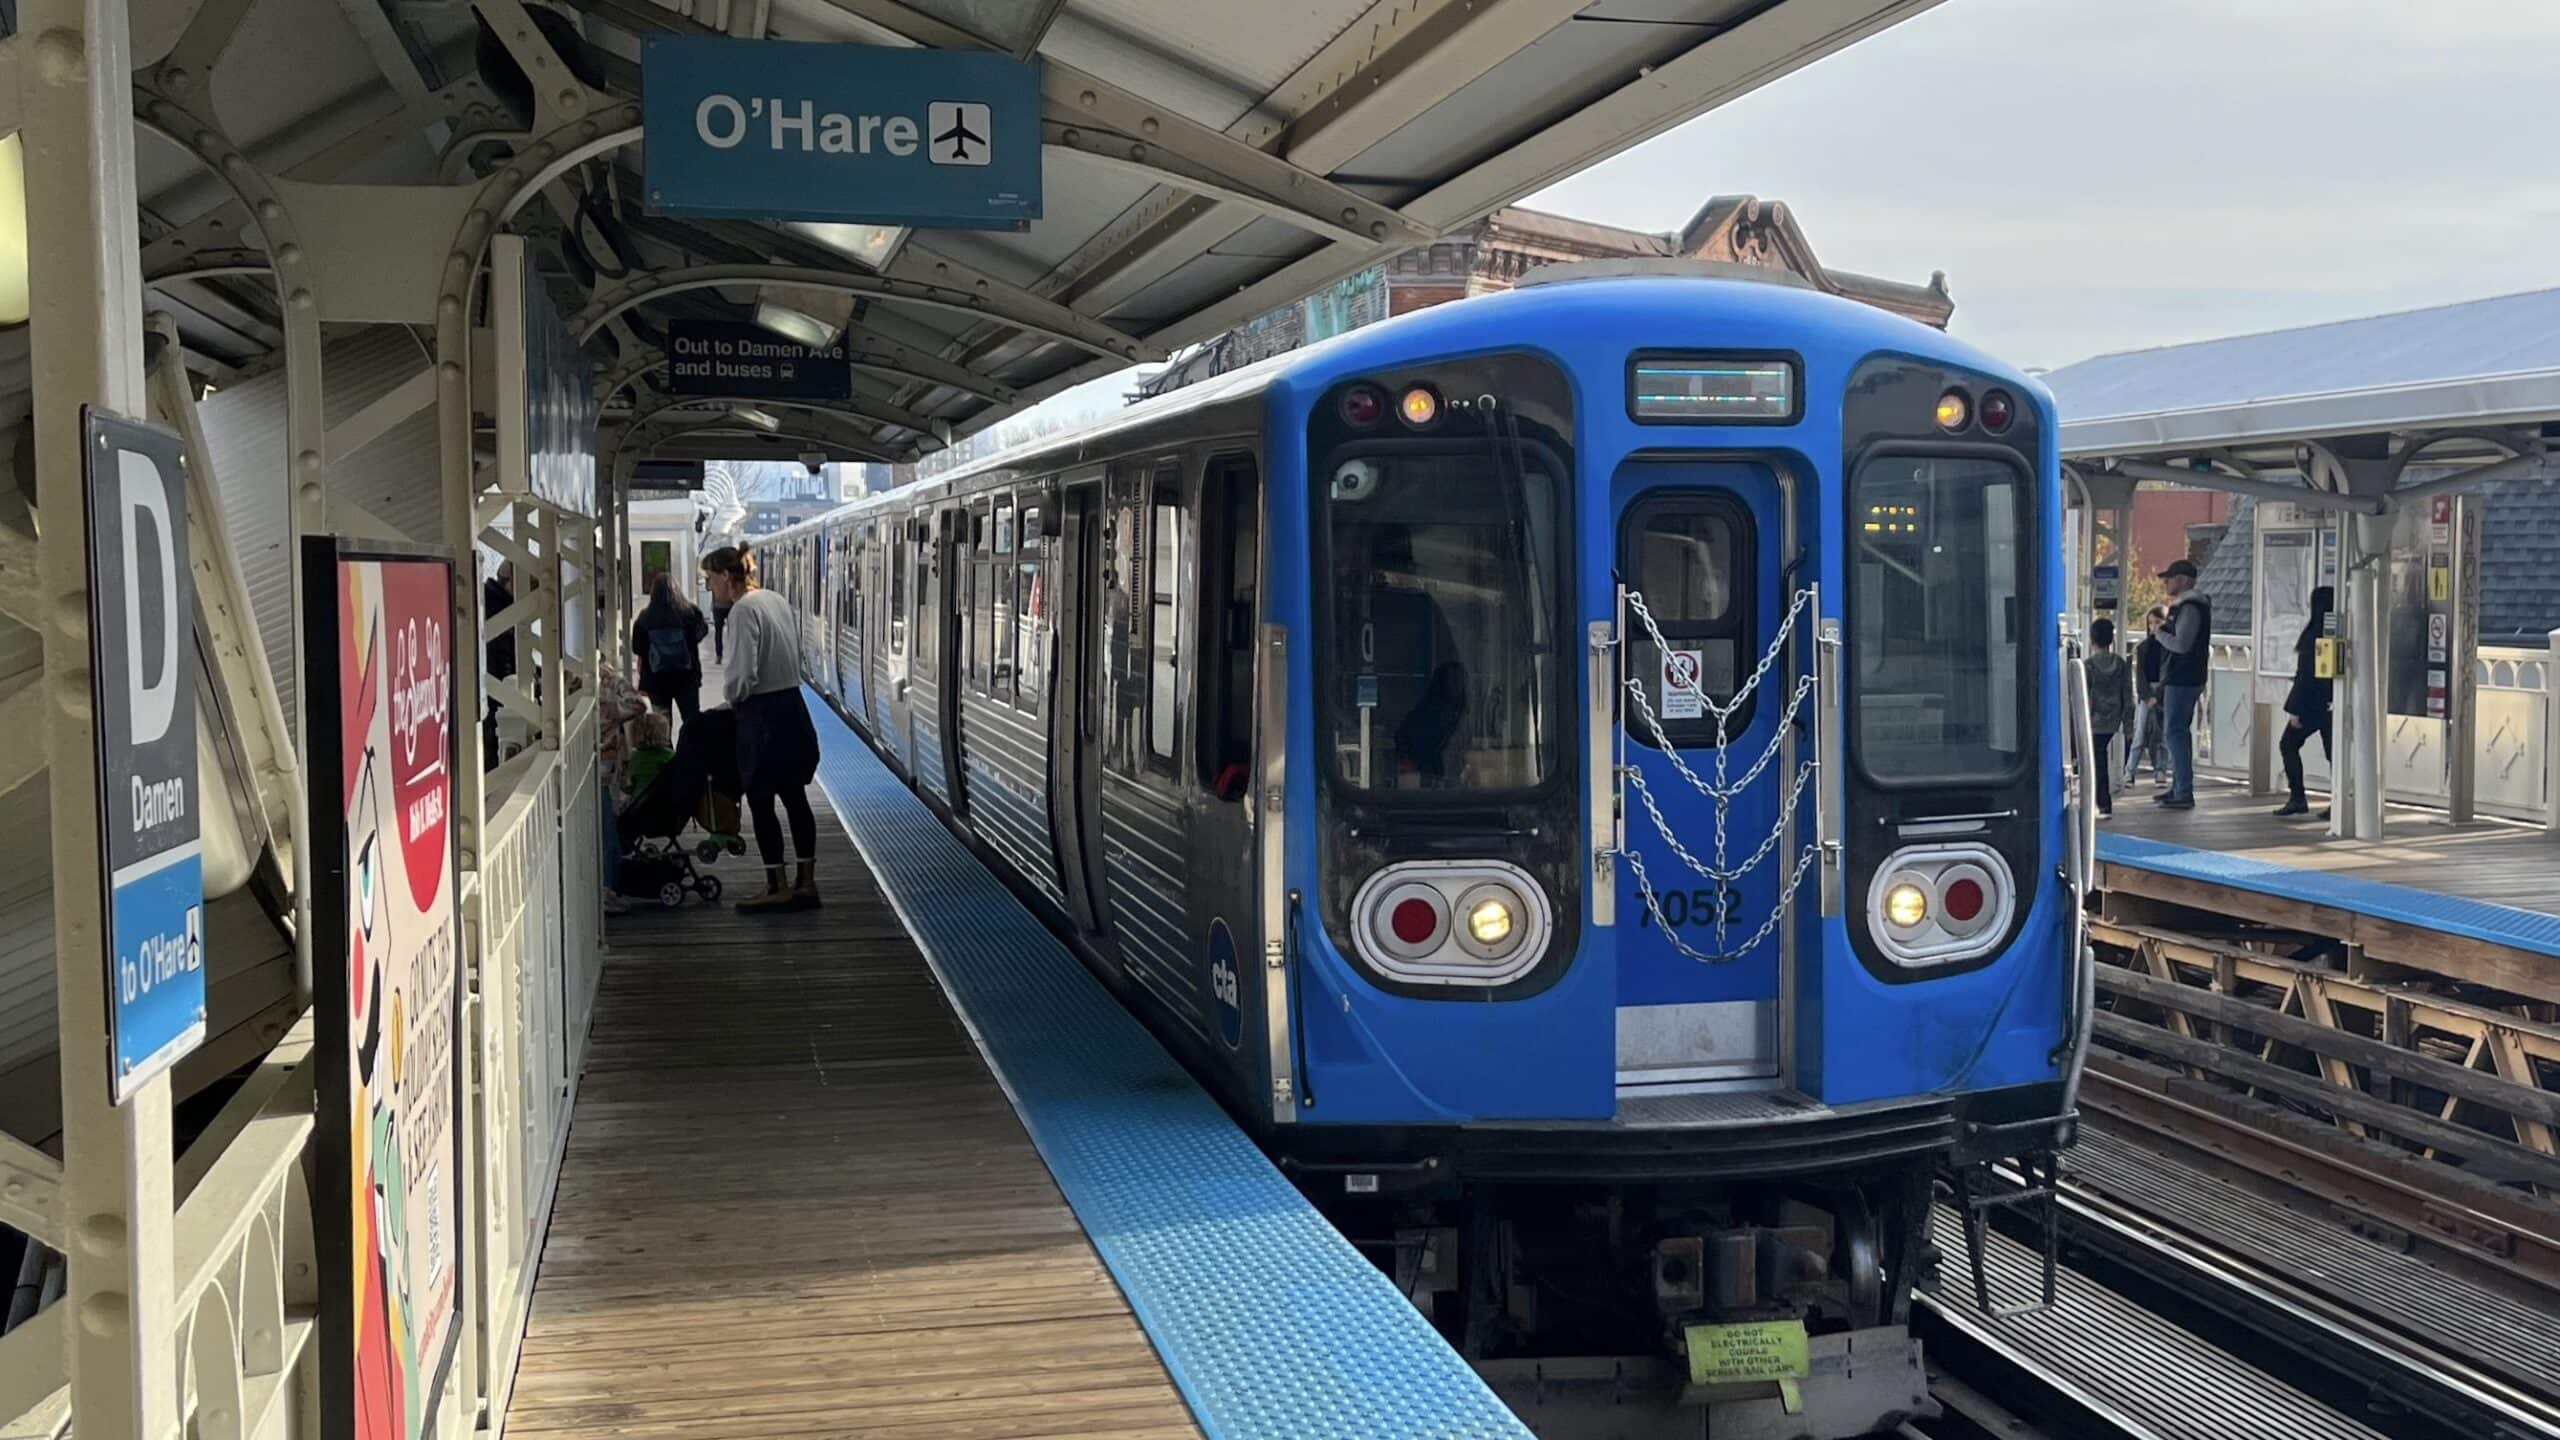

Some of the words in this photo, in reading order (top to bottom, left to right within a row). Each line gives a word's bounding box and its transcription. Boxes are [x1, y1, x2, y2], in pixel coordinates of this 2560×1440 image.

[696, 94, 920, 156] O'Hare
[674, 337, 709, 355] Out
[715, 340, 733, 356] to
[738, 340, 802, 358] Damen
[674, 360, 711, 377] and
[716, 361, 773, 379] buses
[118, 448, 179, 745] D
[131, 774, 185, 833] Damen
[1634, 888, 1743, 928] 7052
[121, 955, 137, 1005] to
[139, 932, 186, 994] O'Hare
[1212, 959, 1238, 1009] cta
[1711, 1337, 1782, 1348] ELECTRICALLY
[1744, 1328, 1764, 1337] NOT
[1719, 1359, 1745, 1367] WITH
[1747, 1357, 1781, 1365] OTHER
[1729, 1348, 1768, 1356] COUPLE
